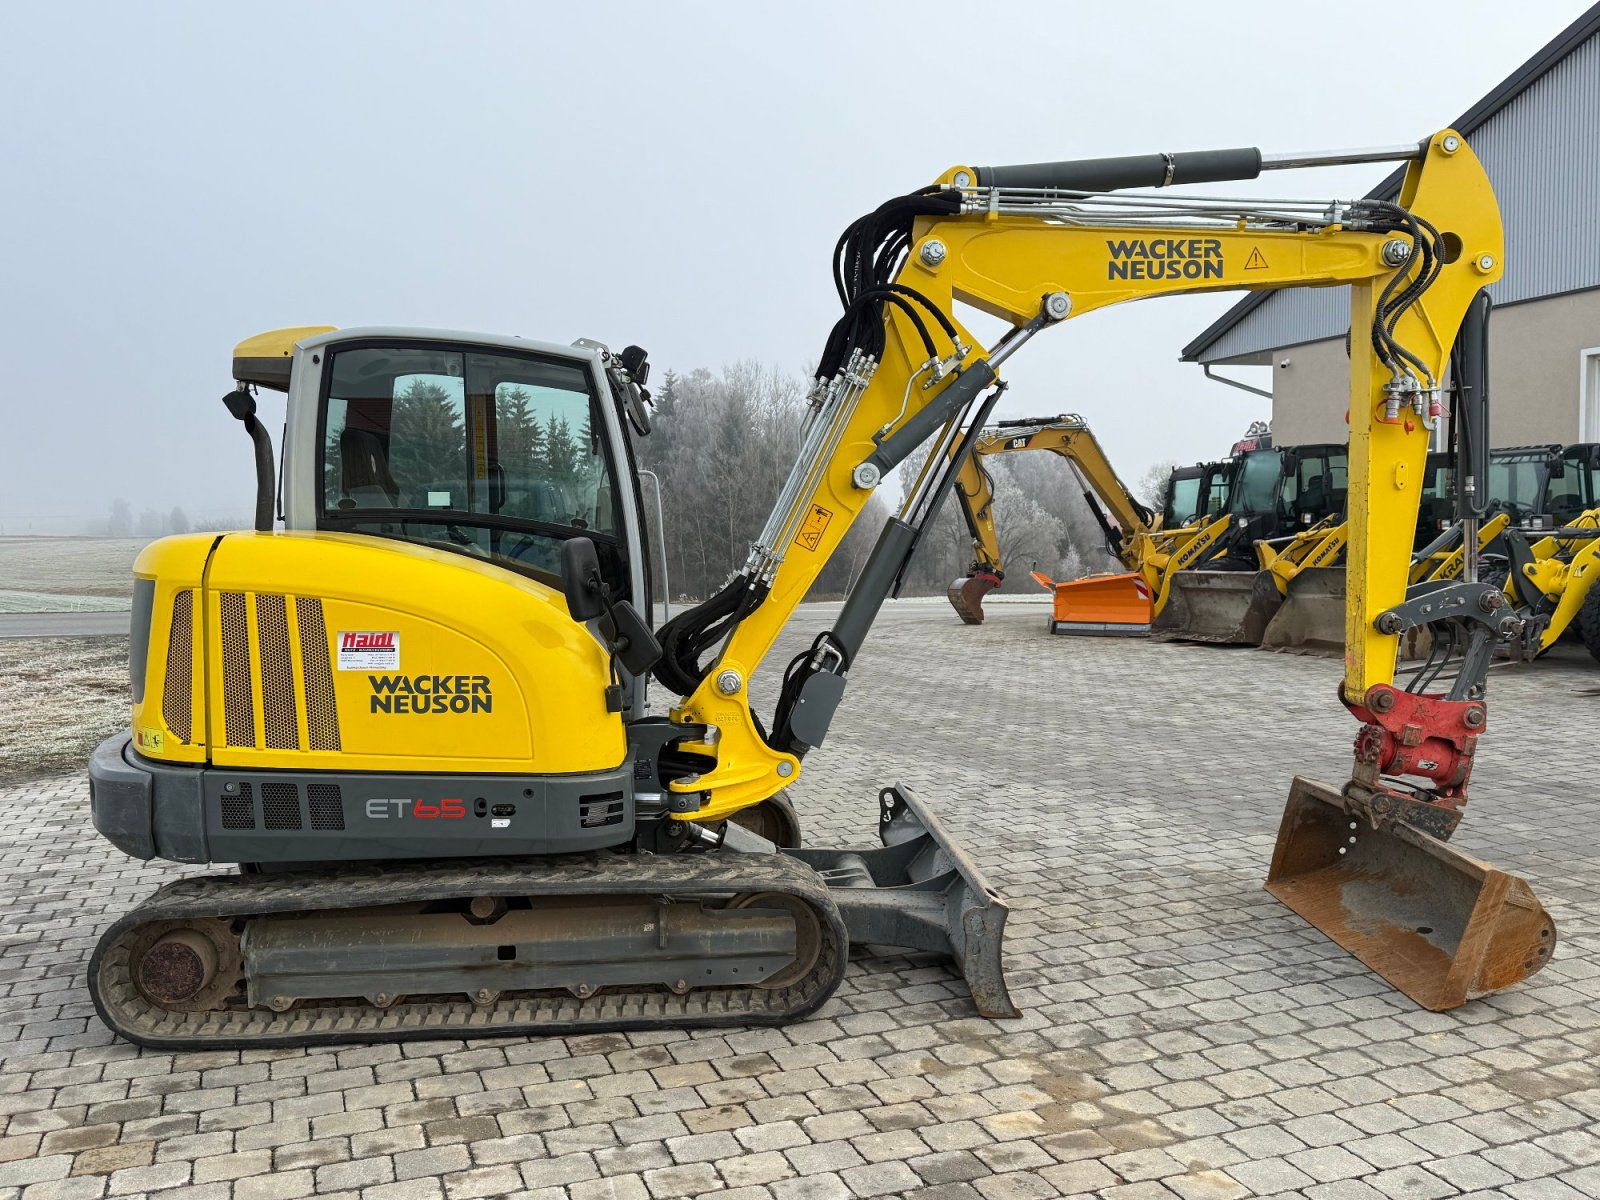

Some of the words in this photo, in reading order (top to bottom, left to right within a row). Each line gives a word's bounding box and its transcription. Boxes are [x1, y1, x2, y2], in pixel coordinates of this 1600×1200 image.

[1106, 239, 1224, 260] WACKER
[1108, 259, 1224, 280] NEUSON
[1013, 438, 1026, 449] CAT
[1177, 533, 1211, 566] KOMATSU
[1312, 537, 1340, 566] KOMATSU
[368, 675, 492, 695] WACKER
[370, 694, 492, 714] NEUSON
[365, 798, 466, 818] ET65
